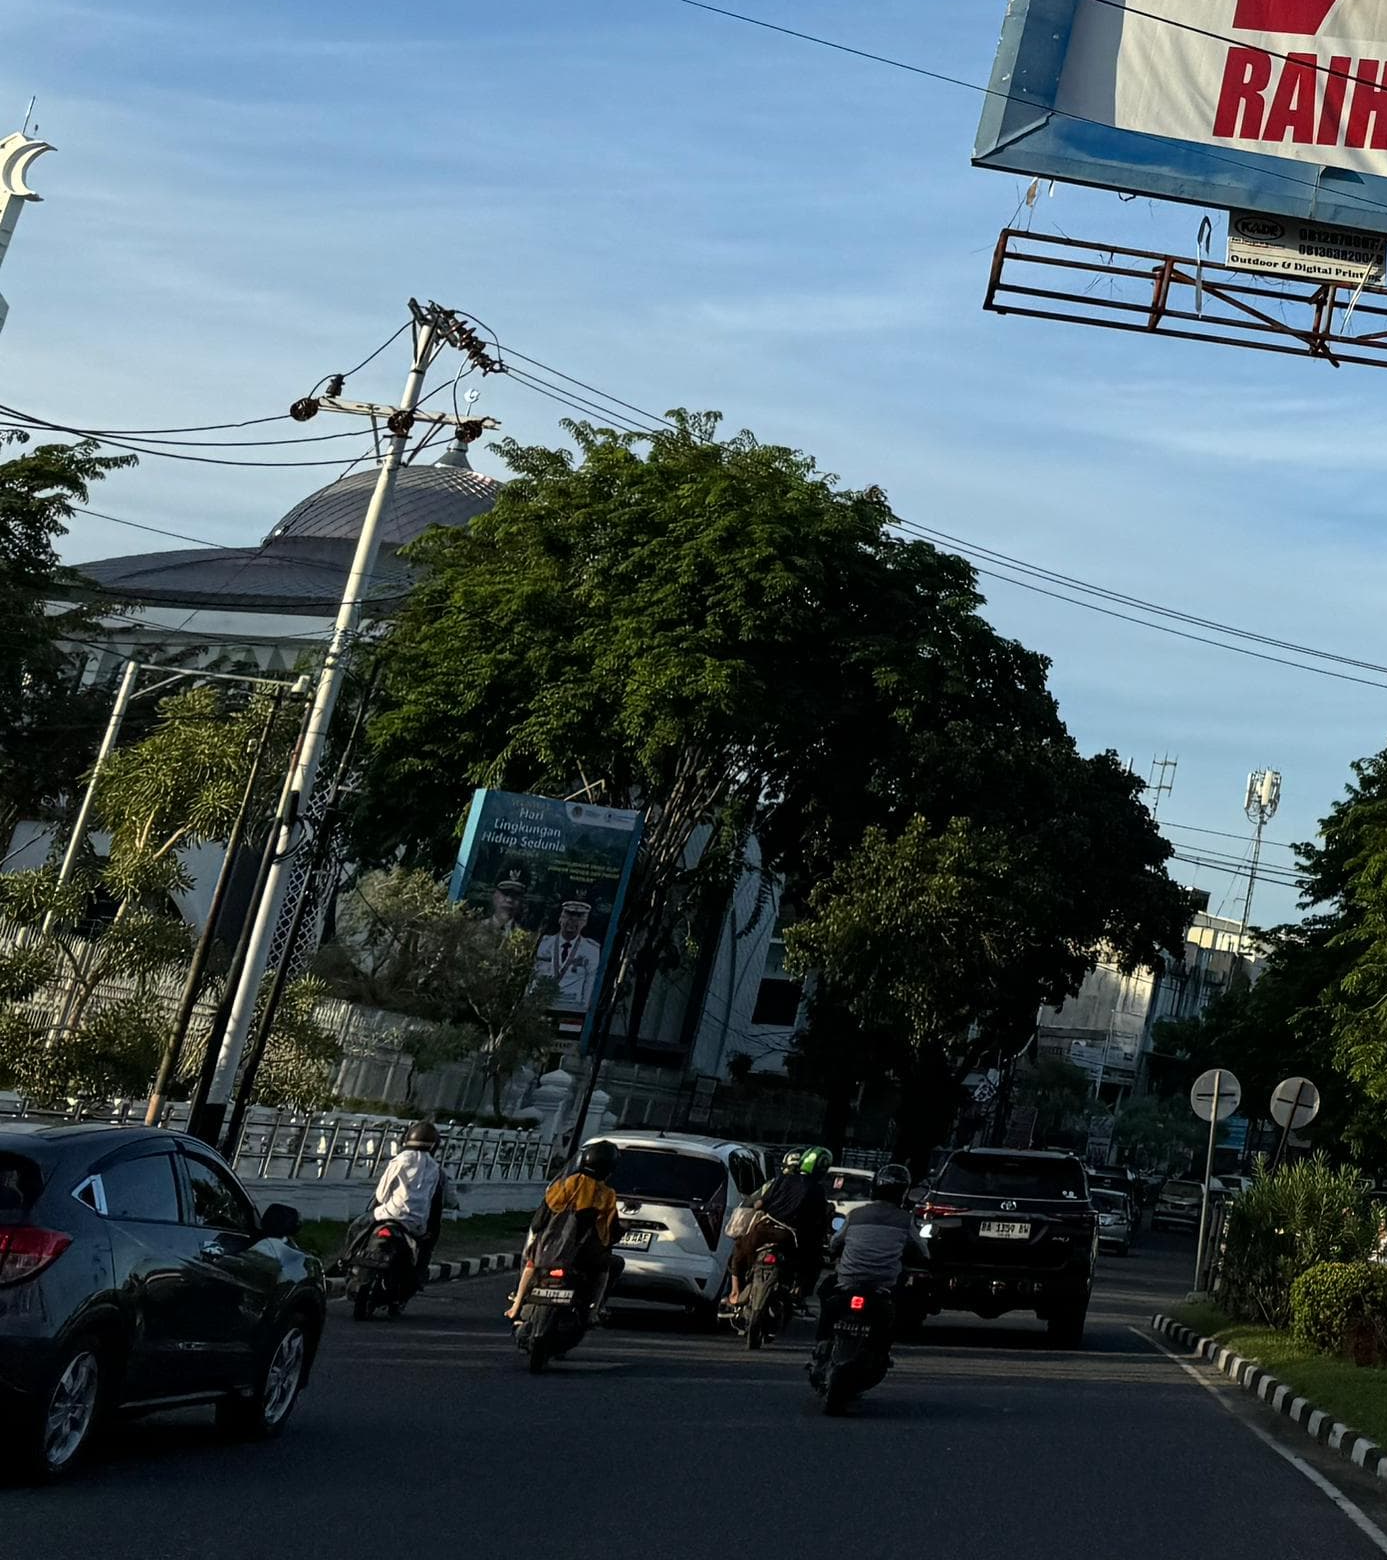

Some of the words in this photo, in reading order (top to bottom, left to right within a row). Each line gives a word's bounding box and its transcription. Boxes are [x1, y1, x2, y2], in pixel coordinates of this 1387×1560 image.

[1230, 254, 1280, 268] Outdoor
[1294, 263, 1332, 275] Digital
[1335, 268, 1382, 282] Printng
[519, 807, 544, 820] Hari
[494, 818, 561, 838] Lingkungan
[481, 831, 518, 849] Hidup
